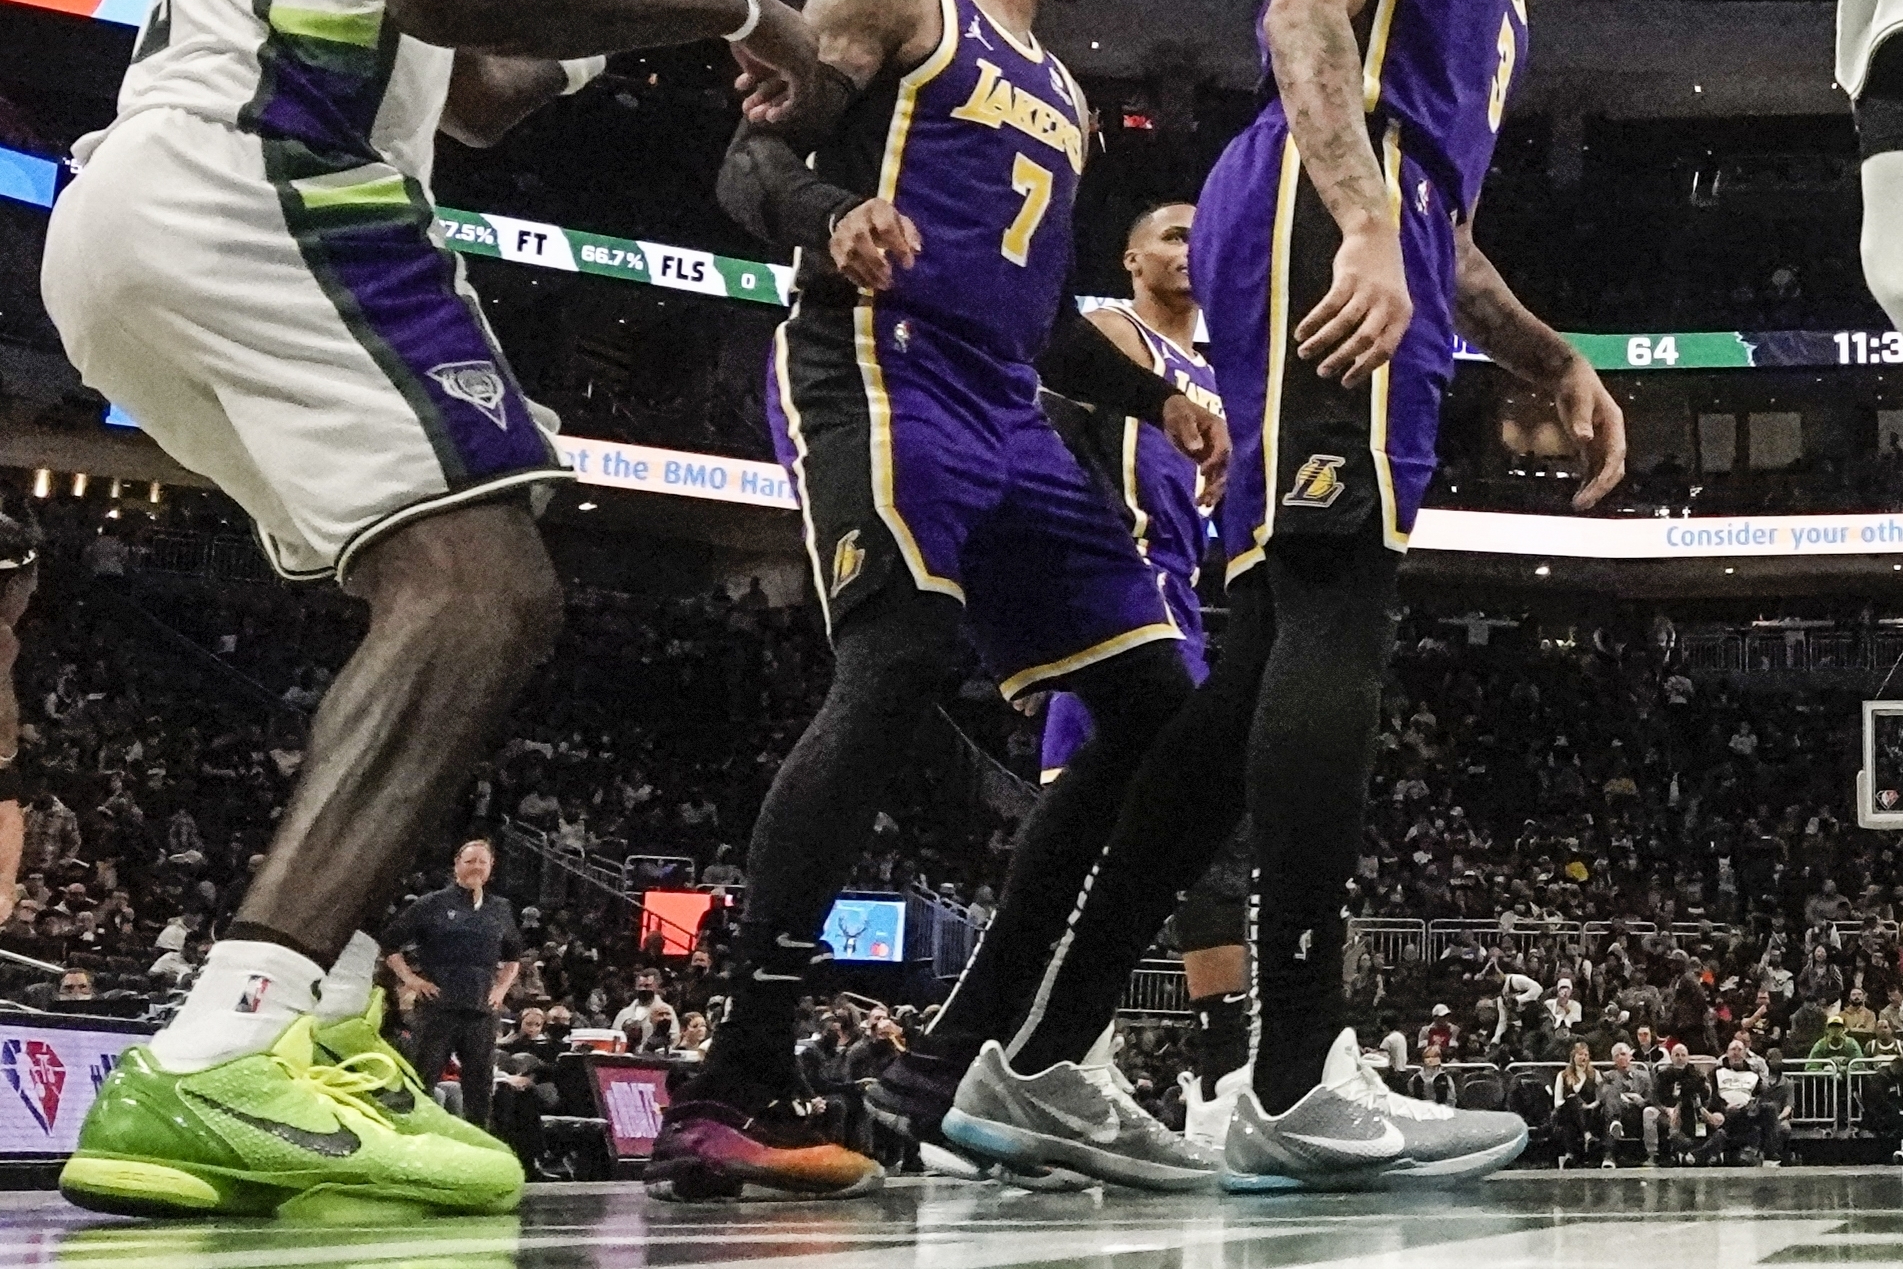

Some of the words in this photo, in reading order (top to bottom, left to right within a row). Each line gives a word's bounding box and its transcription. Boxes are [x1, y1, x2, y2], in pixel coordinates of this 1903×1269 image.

[1001, 151, 1053, 268] 7
[439, 219, 495, 246] 7.5%
[517, 230, 548, 255] FT
[581, 245, 644, 271] 66.7%
[661, 255, 705, 283] FLS
[741, 273, 756, 290] 0
[1627, 336, 1679, 366] 64
[603, 451, 649, 480] the
[664, 461, 727, 490] BMO
[1666, 522, 1777, 548] Consider
[1792, 526, 1850, 551] your
